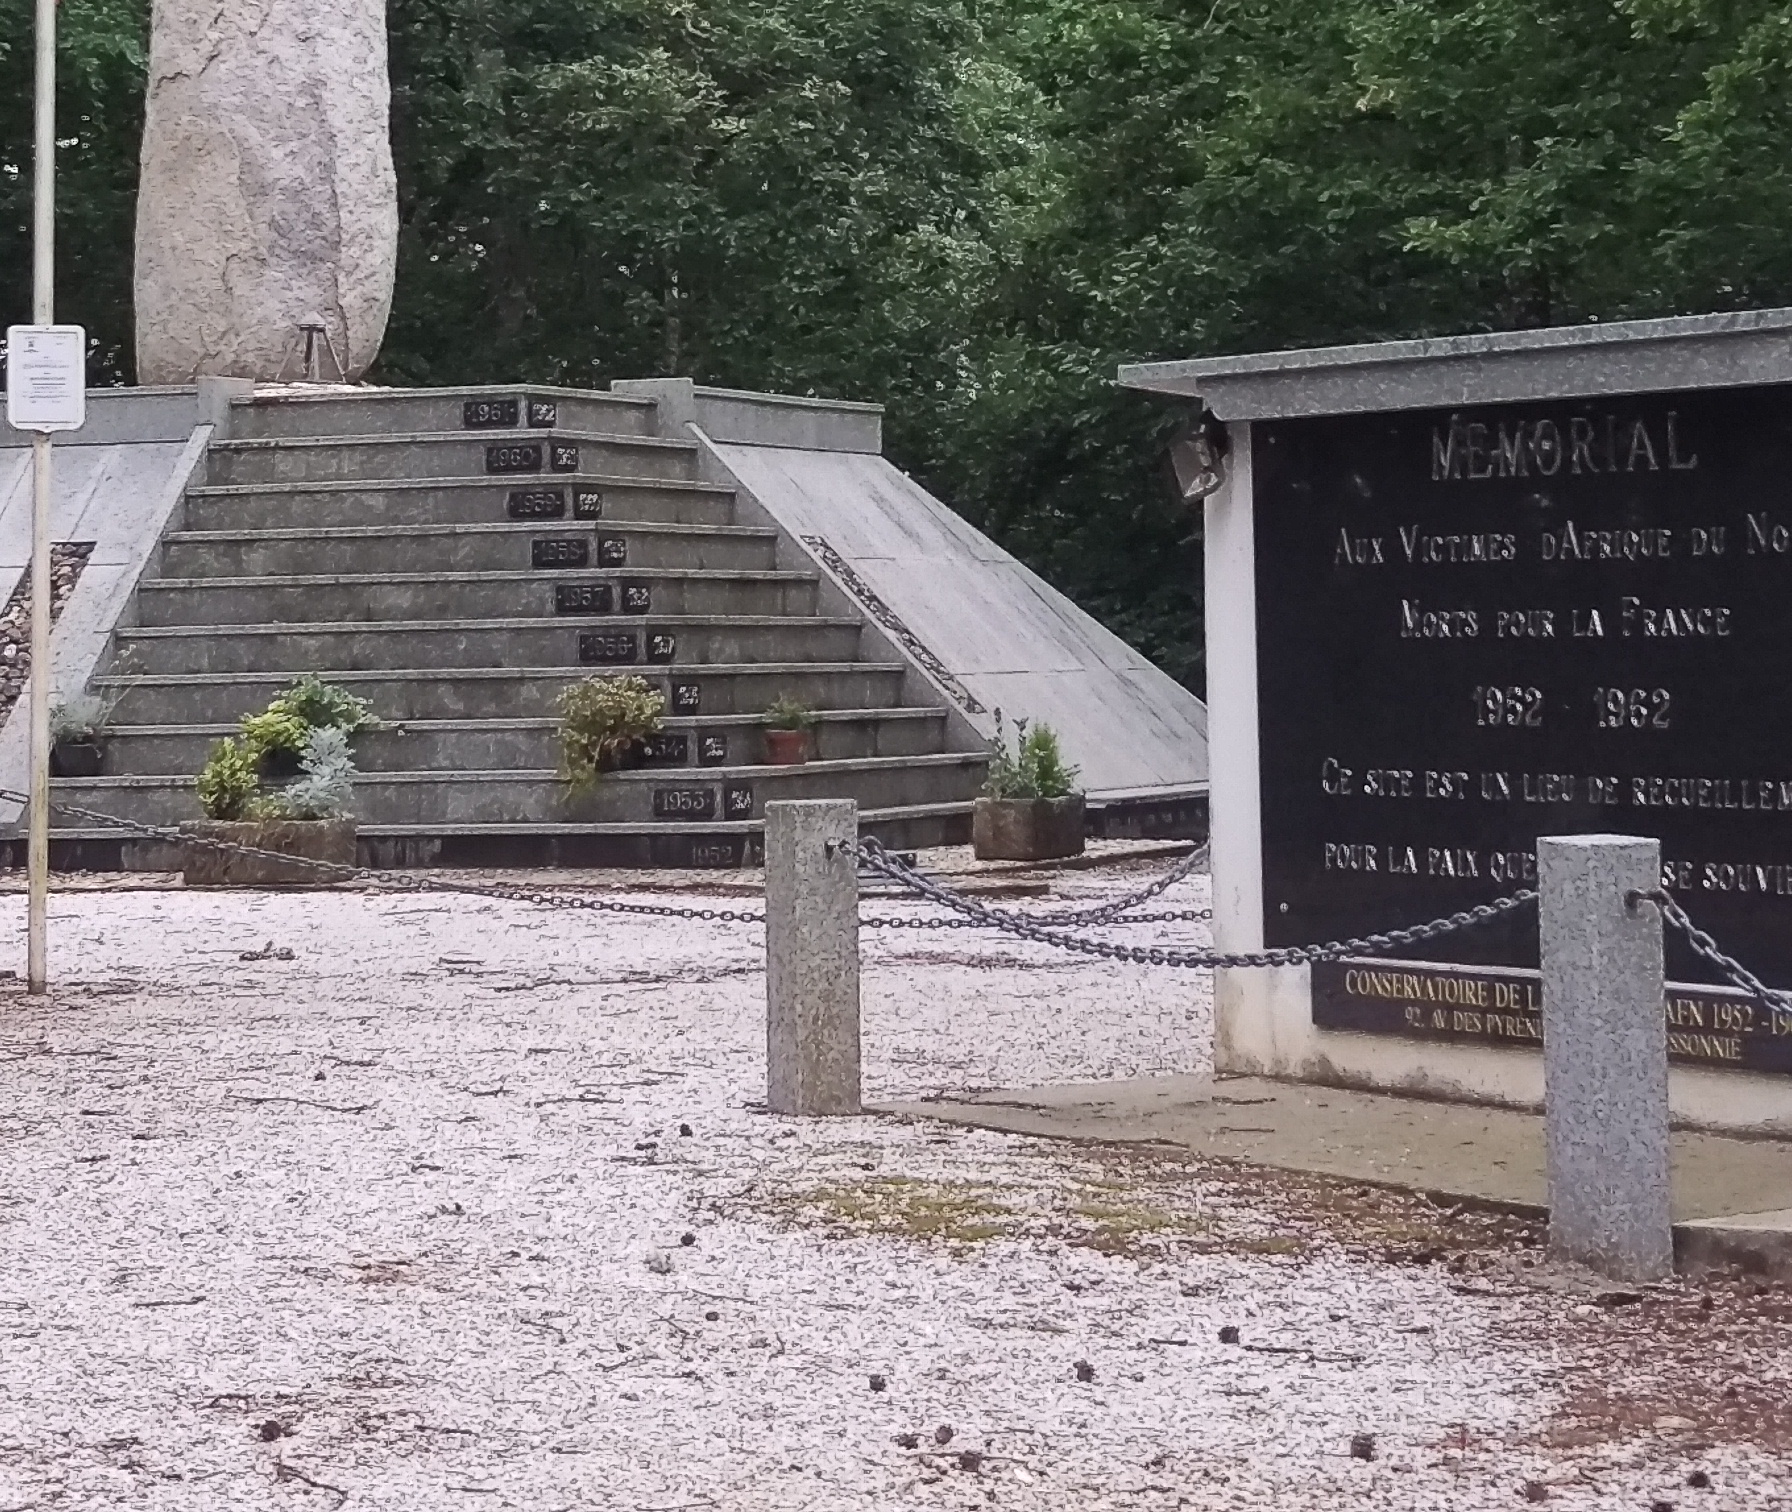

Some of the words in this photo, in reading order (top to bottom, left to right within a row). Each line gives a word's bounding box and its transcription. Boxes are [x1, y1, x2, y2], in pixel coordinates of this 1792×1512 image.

[1472, 685, 1543, 726] 1952
[1593, 686, 1670, 729] 1962
[1425, 769, 1469, 800] EST
[1324, 842, 1378, 872] POUR
[1388, 845, 1418, 874] LA
[1428, 846, 1479, 878] PAIX
[1345, 969, 1488, 1007] CONSERVATOIRE
[1494, 982, 1521, 1009] DE
[1713, 1002, 1754, 1032] 1952
[1453, 1010, 1482, 1033] DES
